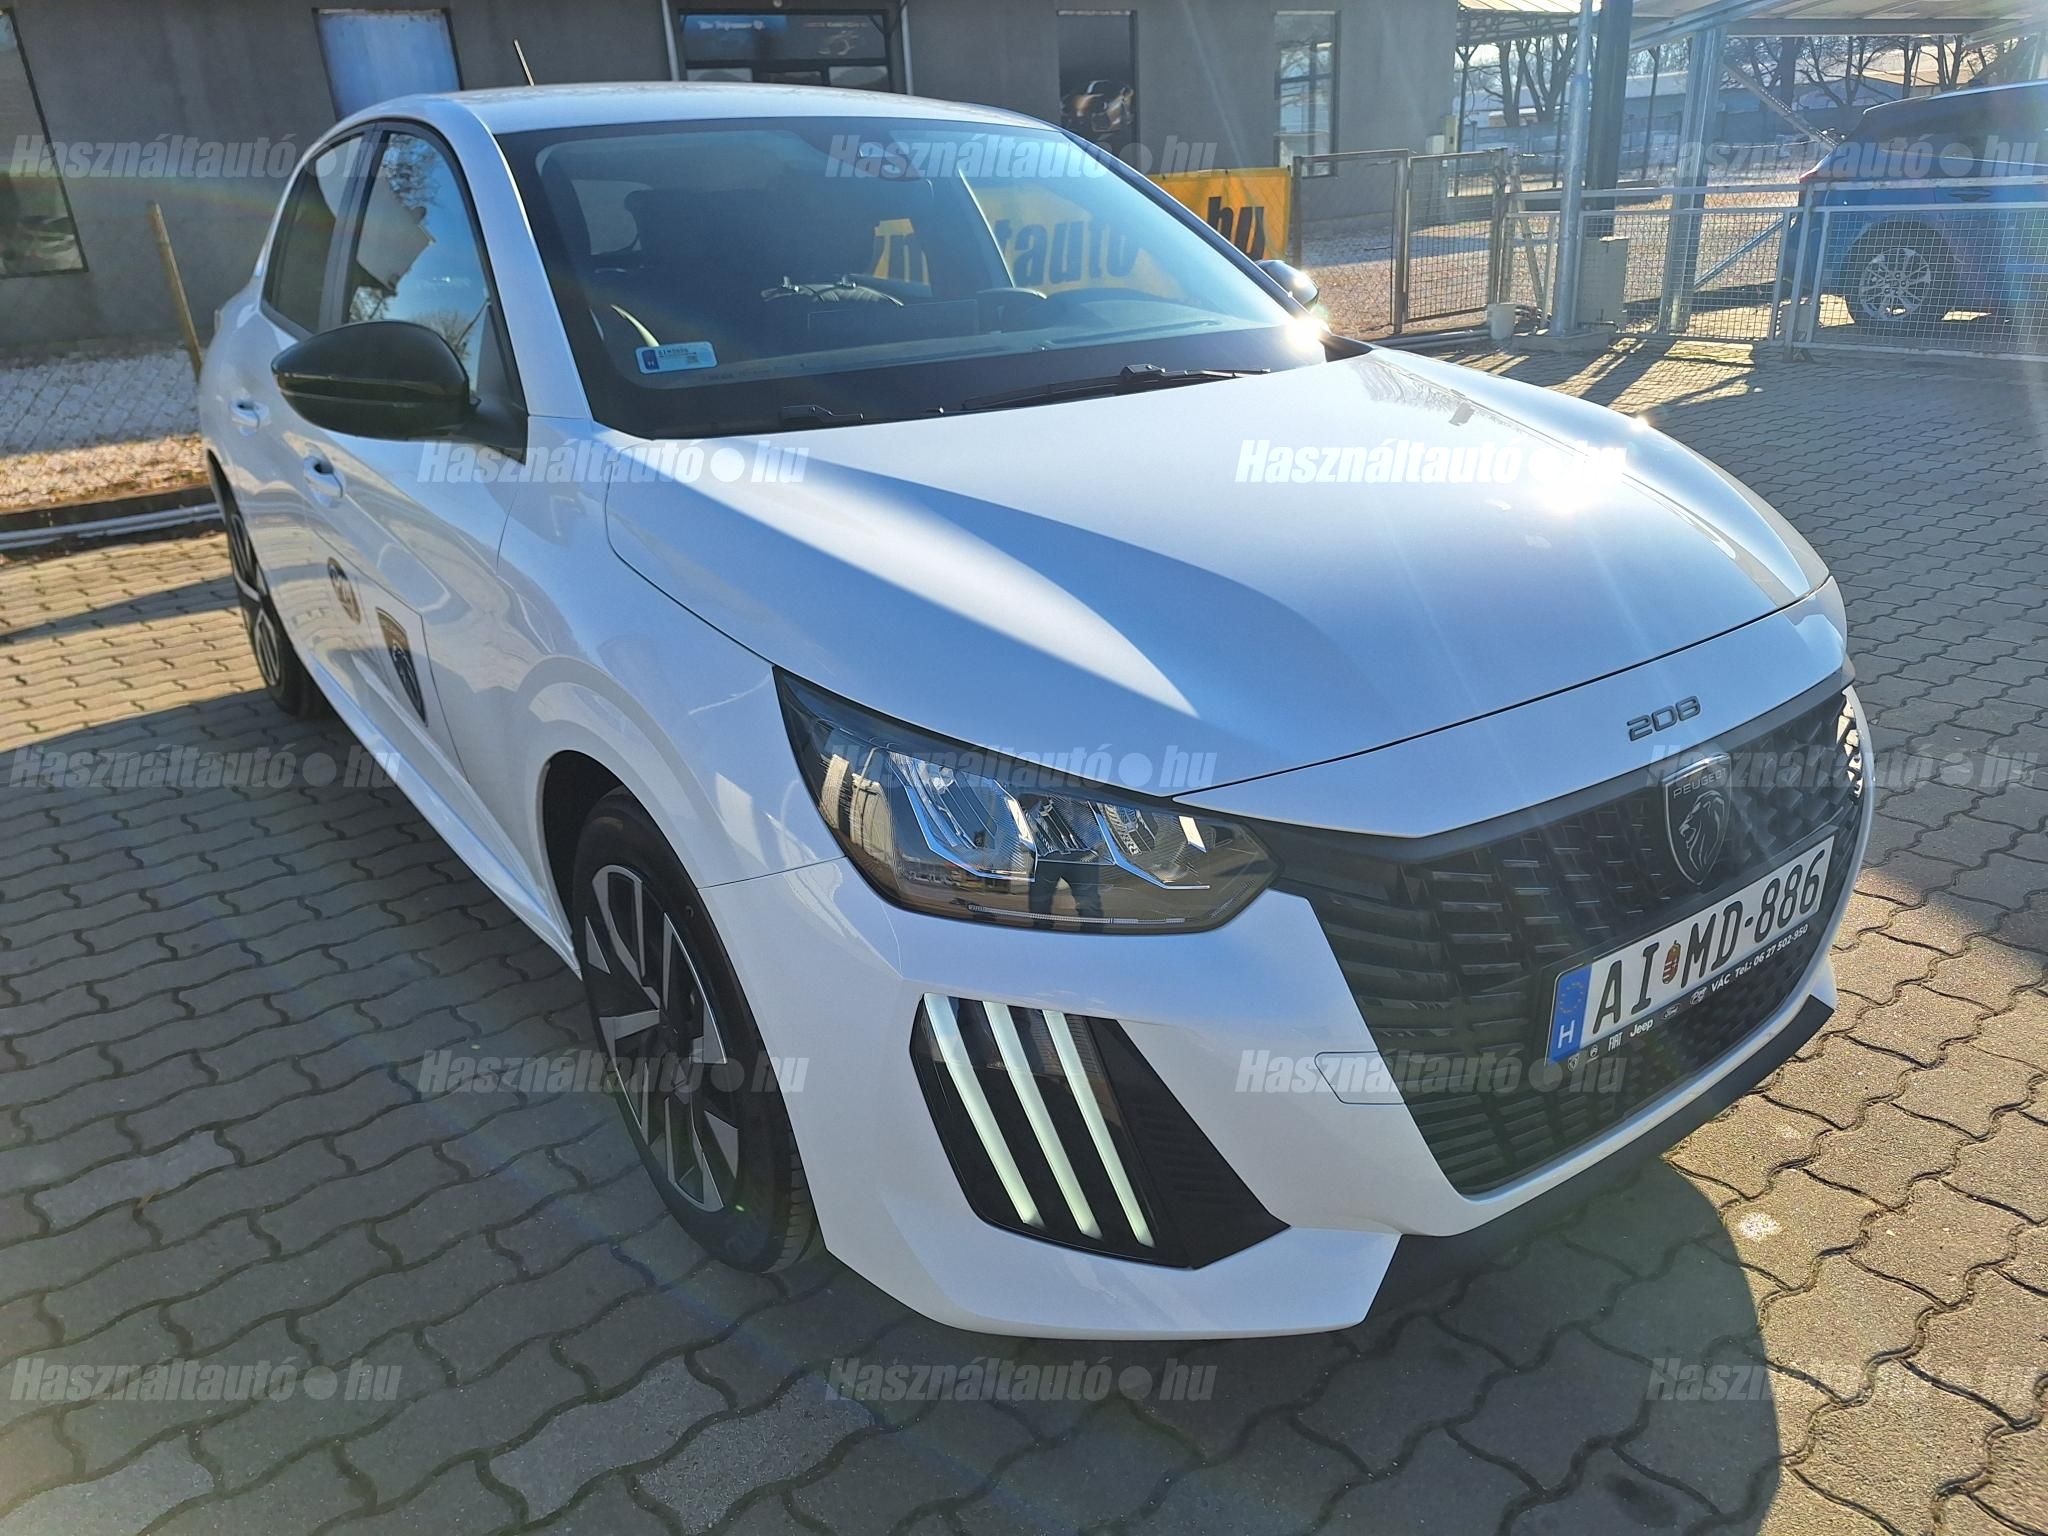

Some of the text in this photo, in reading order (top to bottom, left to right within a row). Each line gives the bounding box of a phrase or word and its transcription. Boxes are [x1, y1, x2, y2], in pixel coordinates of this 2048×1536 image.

[1626, 695, 1701, 742] 208
[1673, 767, 1727, 799] PEUGEOT
[1557, 849, 1825, 1049] H AI MD-886
[1607, 1032, 1623, 1051] FIAT
[1630, 1019, 1654, 1037] Jeep
[1711, 974, 1731, 992] VÁC
[1753, 953, 1765, 967] 06
[1765, 945, 1777, 959] 27
